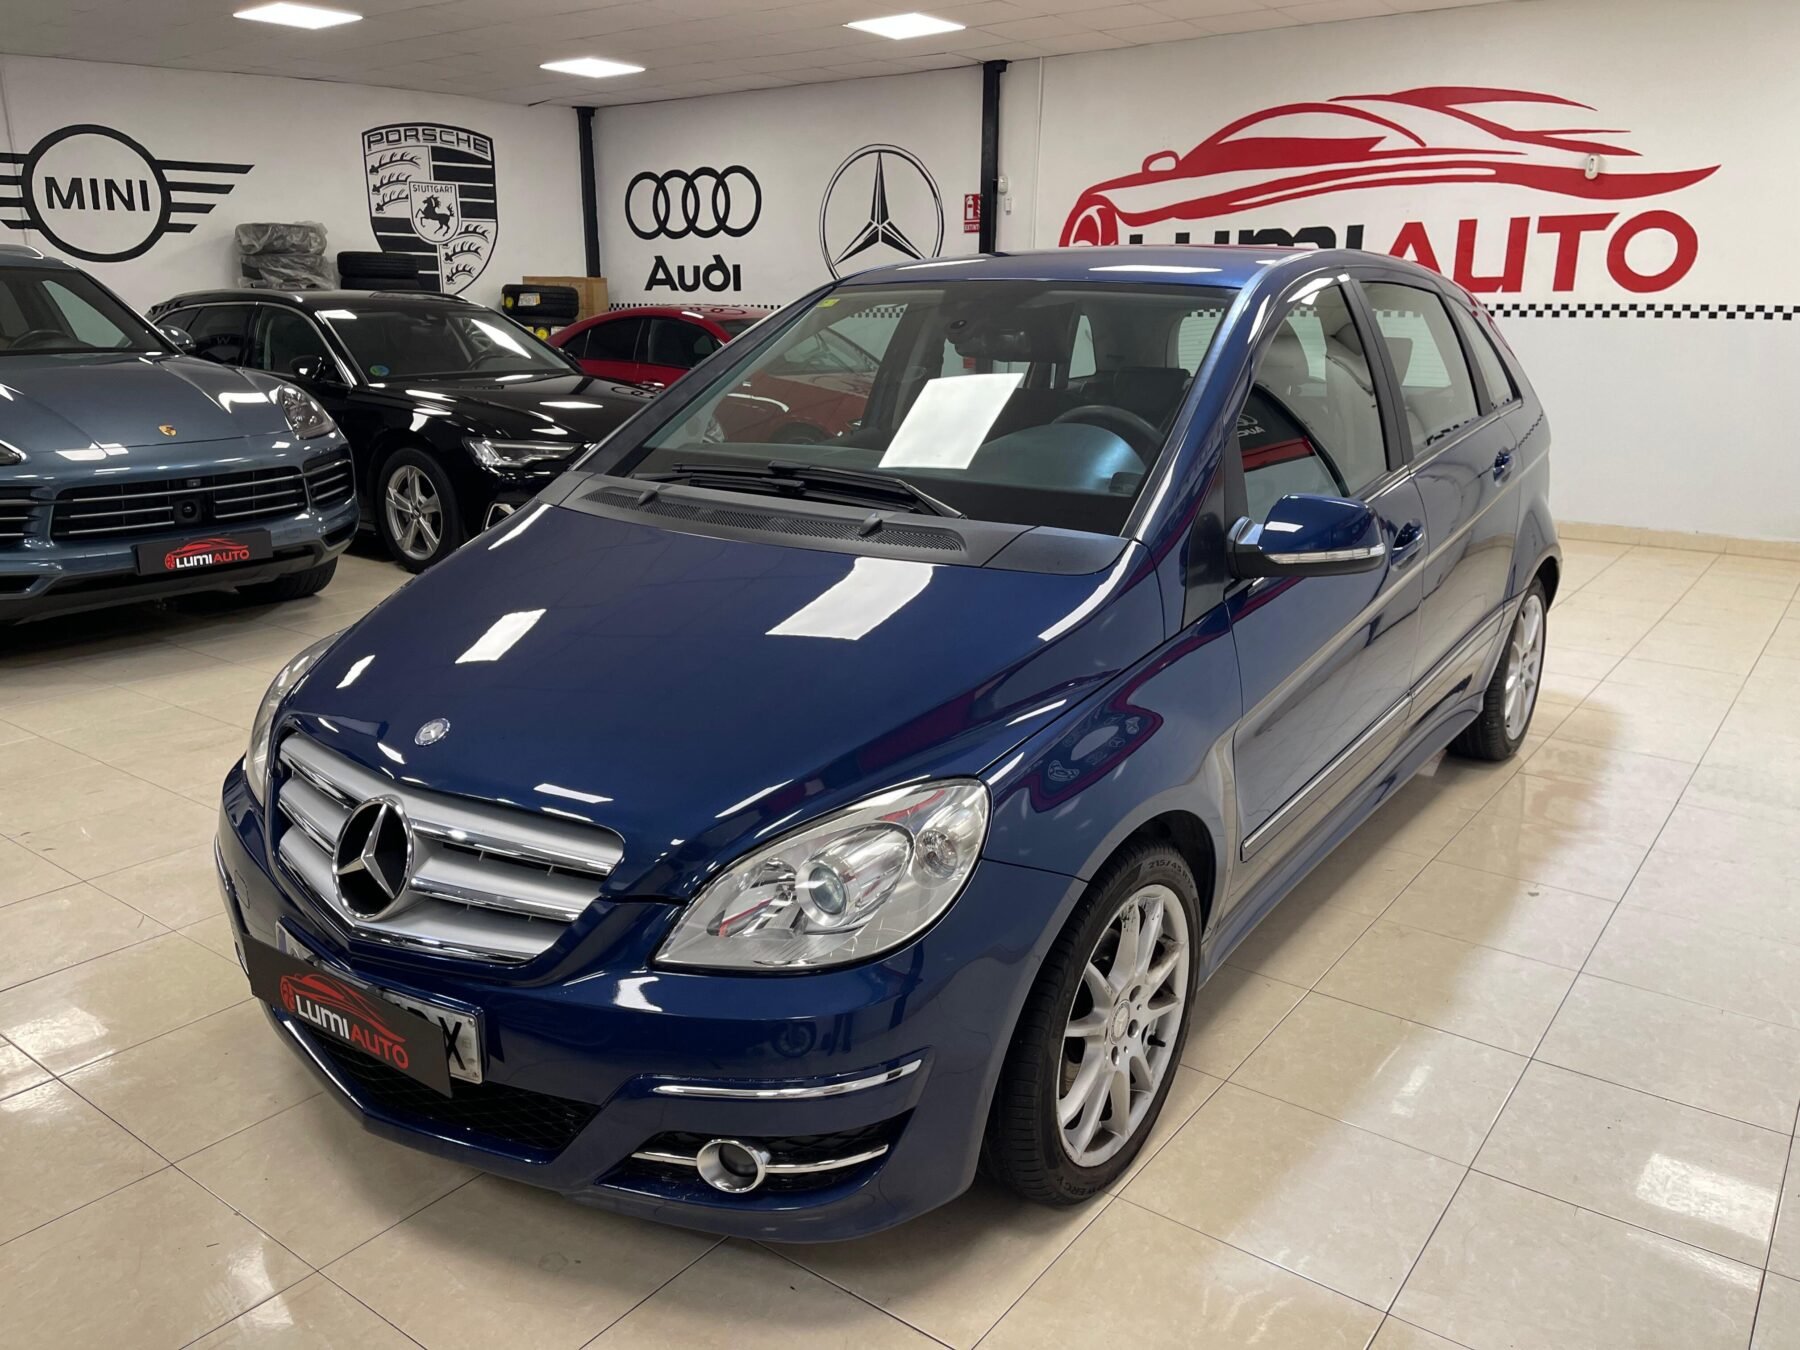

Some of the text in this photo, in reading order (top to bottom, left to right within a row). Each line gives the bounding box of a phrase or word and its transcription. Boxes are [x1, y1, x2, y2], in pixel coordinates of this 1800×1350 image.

[366, 127, 490, 156] PORSCHE
[44, 175, 151, 213] MINI
[412, 184, 454, 194] STUTTGART
